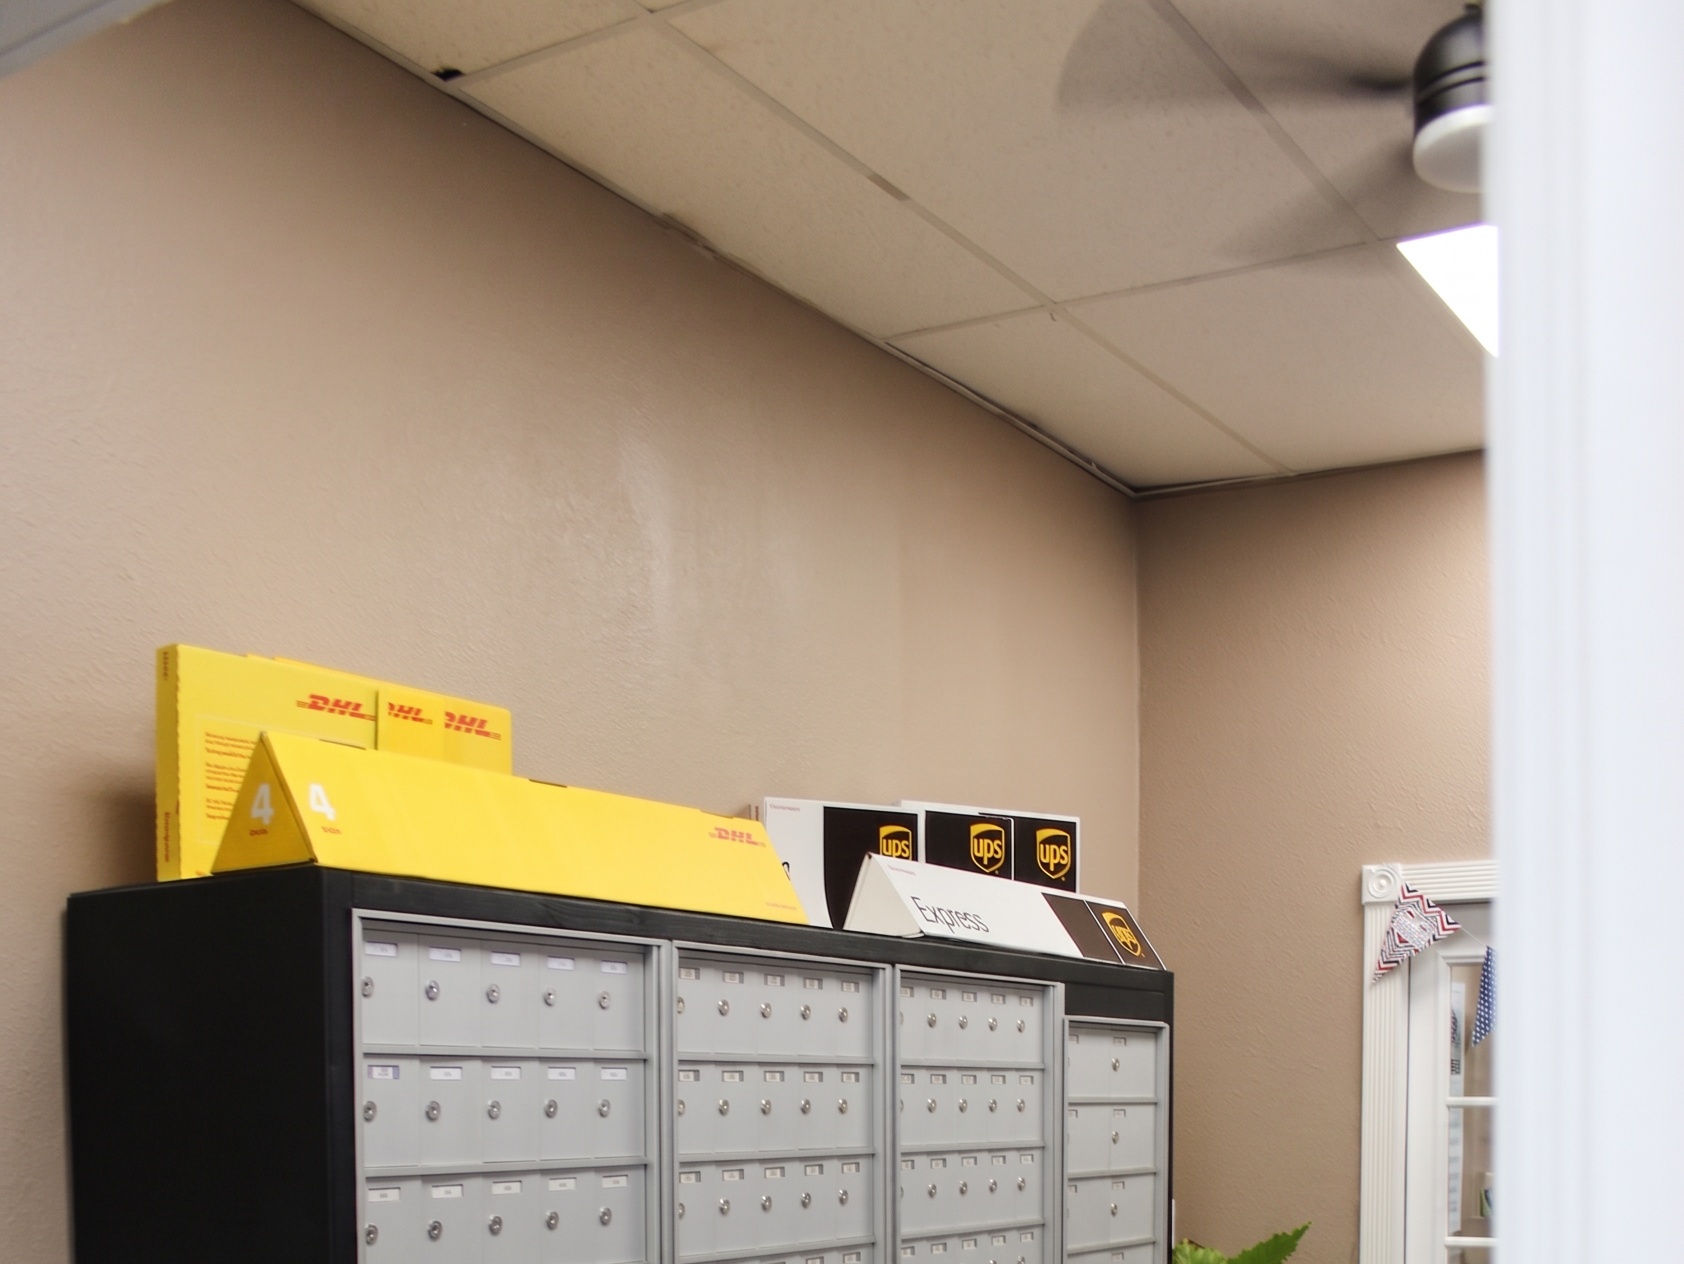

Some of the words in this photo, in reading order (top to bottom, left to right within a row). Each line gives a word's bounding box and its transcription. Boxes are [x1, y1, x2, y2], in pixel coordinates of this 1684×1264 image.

[305, 693, 369, 720] DHL
[251, 782, 274, 825] 4
[309, 782, 336, 821] 4
[713, 826, 760, 846] DHL
[973, 837, 1003, 866] ups
[1039, 843, 1069, 872] ups
[910, 895, 990, 934] Express
[1111, 924, 1138, 951] ups
